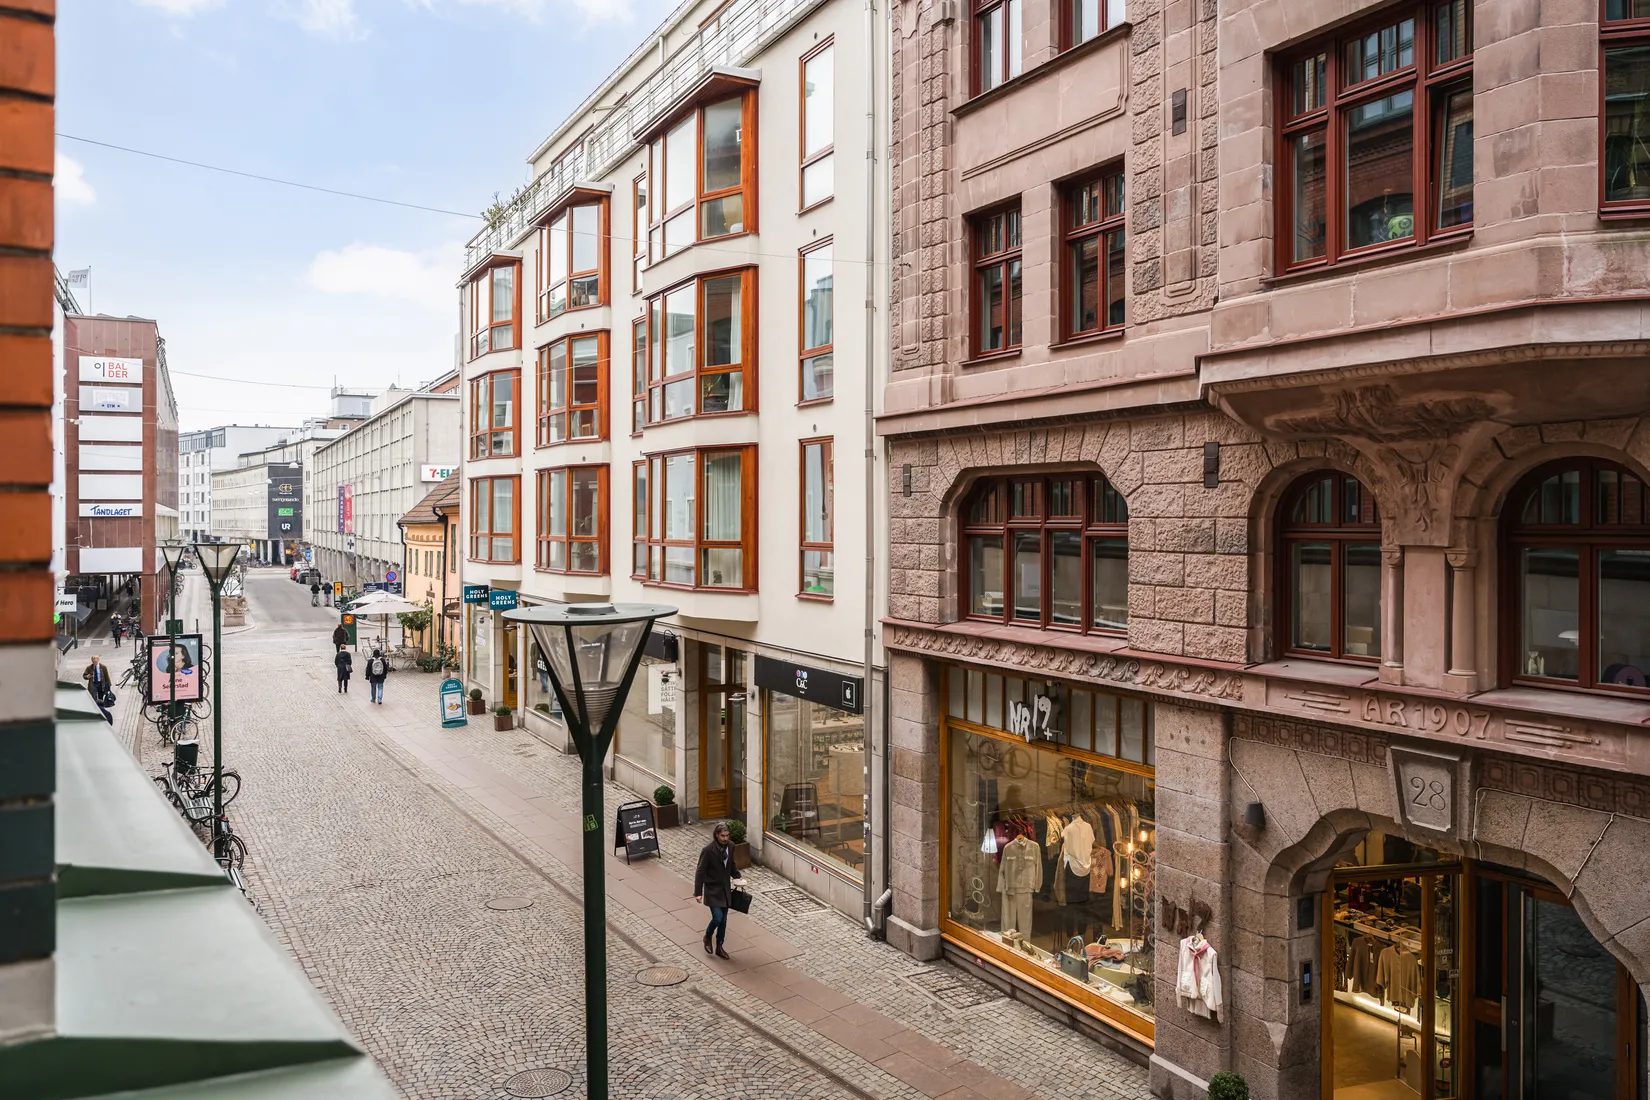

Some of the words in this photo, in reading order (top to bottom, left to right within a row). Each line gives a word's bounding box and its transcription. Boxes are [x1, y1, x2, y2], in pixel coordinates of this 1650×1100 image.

[108, 362, 128, 370] BAL
[108, 370, 129, 378] DER
[90, 505, 133, 516] TANDLAGET
[281, 523, 291, 531] UR
[1412, 701, 1491, 740] 1907
[1410, 776, 1446, 811] 28
